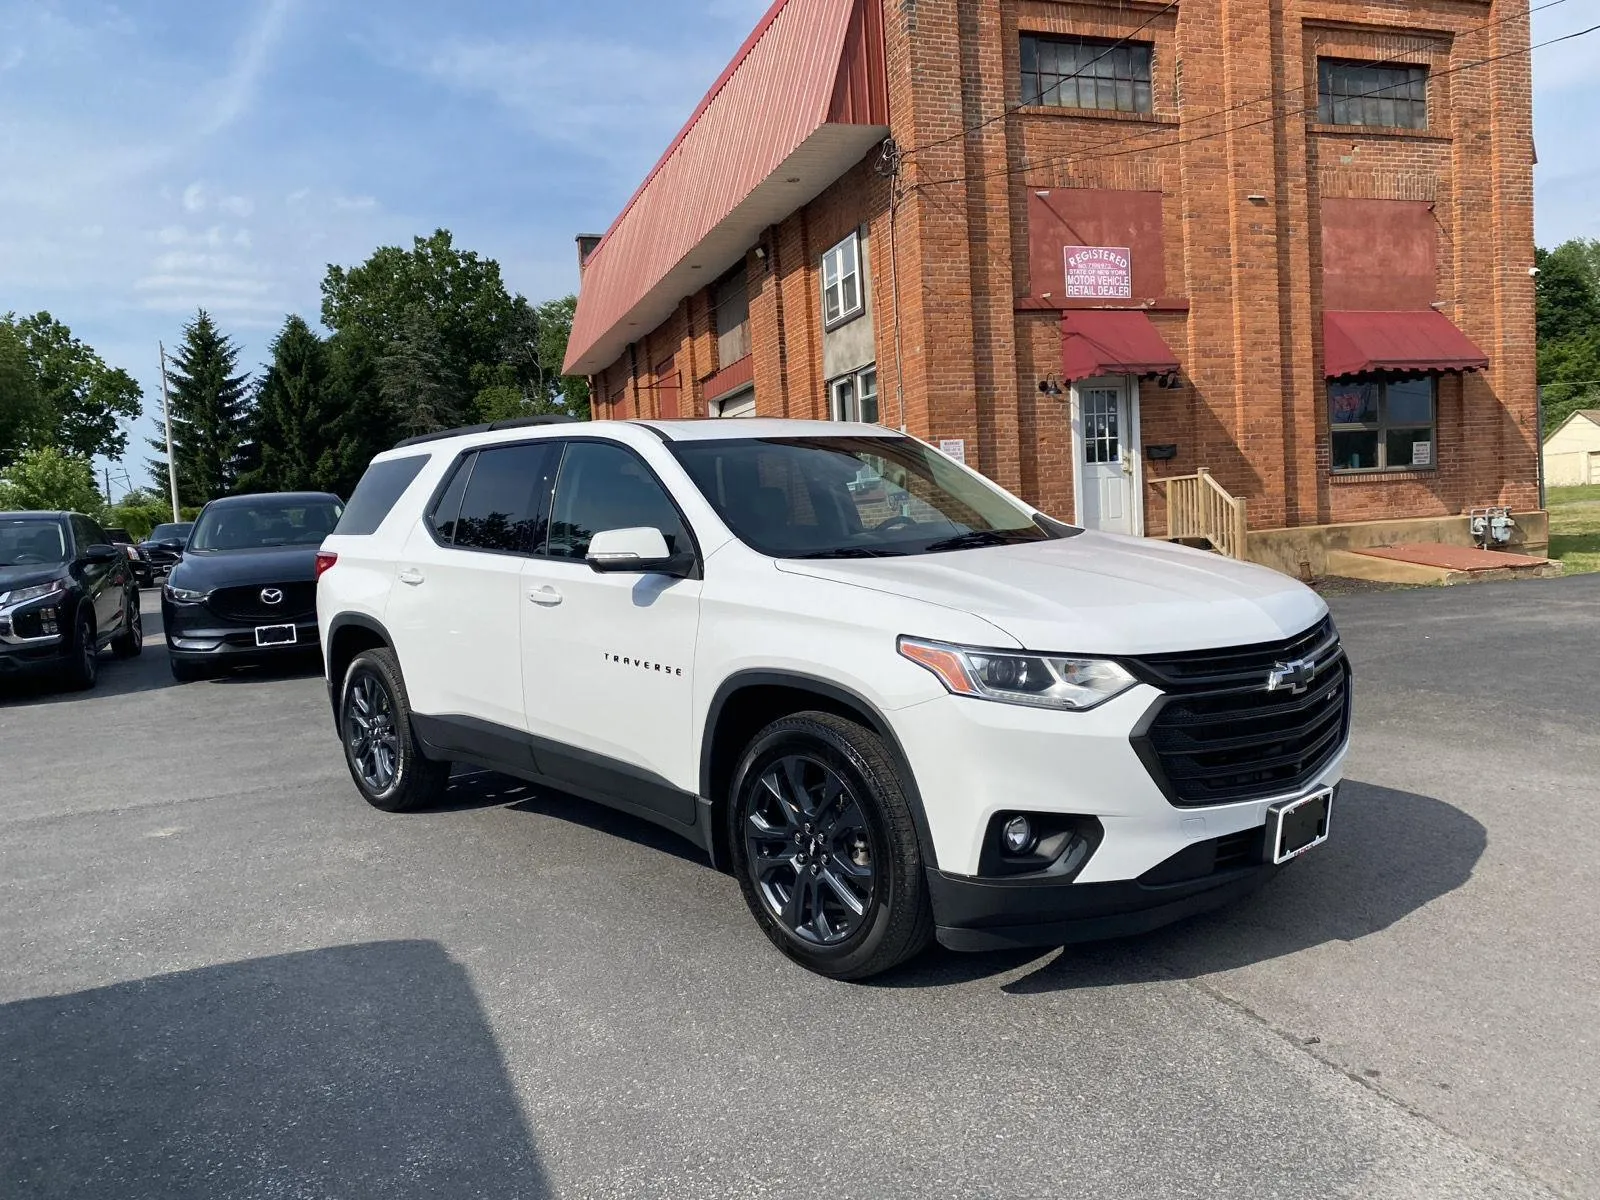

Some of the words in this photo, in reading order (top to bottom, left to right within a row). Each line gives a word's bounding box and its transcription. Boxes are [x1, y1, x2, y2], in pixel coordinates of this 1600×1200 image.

[1069, 249, 1127, 268] REGISTERED
[1068, 275, 1095, 285] MOTOR
[1097, 276, 1129, 286] VEHICLE
[1068, 286, 1096, 295] RETAIL
[1098, 286, 1129, 296] DEALER
[604, 652, 682, 676] TRAVERSE
